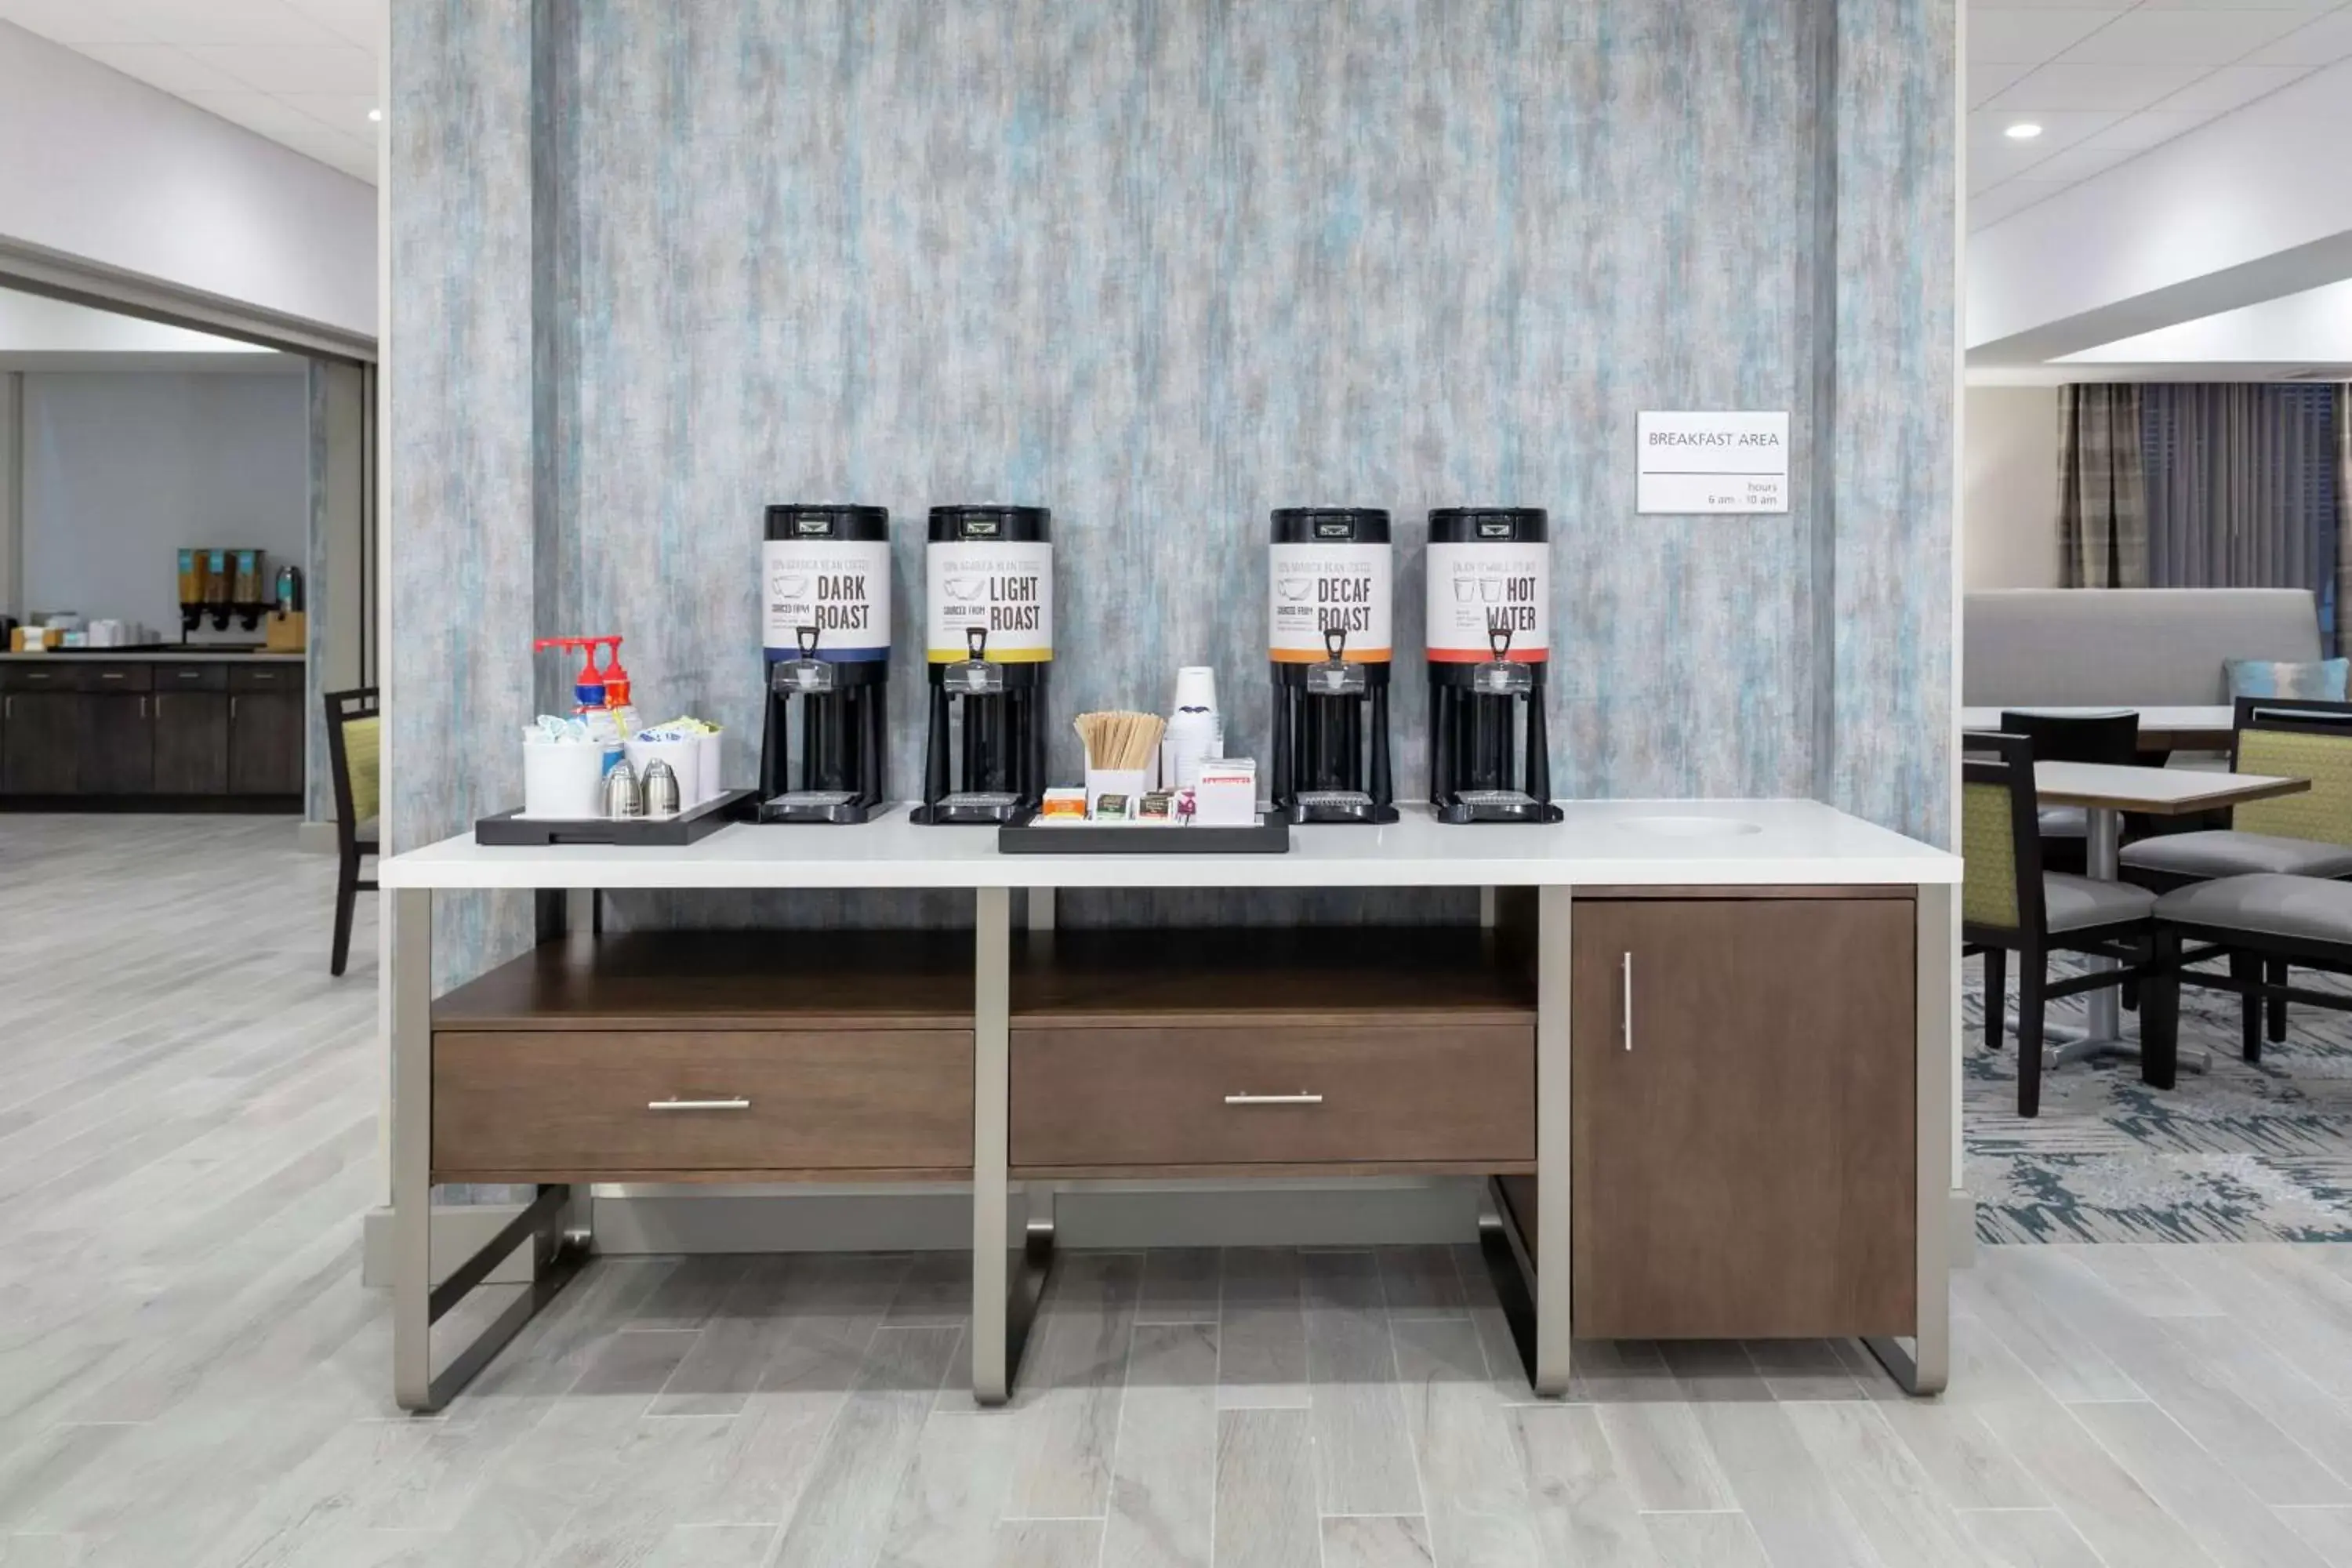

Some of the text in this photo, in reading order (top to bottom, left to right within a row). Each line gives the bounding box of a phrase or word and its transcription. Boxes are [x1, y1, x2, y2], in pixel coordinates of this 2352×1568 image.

[1649, 433, 1780, 446] BREAKFAST AREA
[1748, 482, 1777, 492] hours
[1708, 495, 1715, 503] 6
[1760, 496, 1777, 505] am
[818, 575, 866, 600] DARK
[990, 576, 1038, 601] LIGHT
[1318, 578, 1370, 602] DECAF
[1507, 577, 1536, 602] HOT
[815, 604, 869, 630] ROAST
[990, 606, 1040, 630] ROAST
[1318, 606, 1371, 632] ROAST
[1486, 606, 1536, 630] WATER
